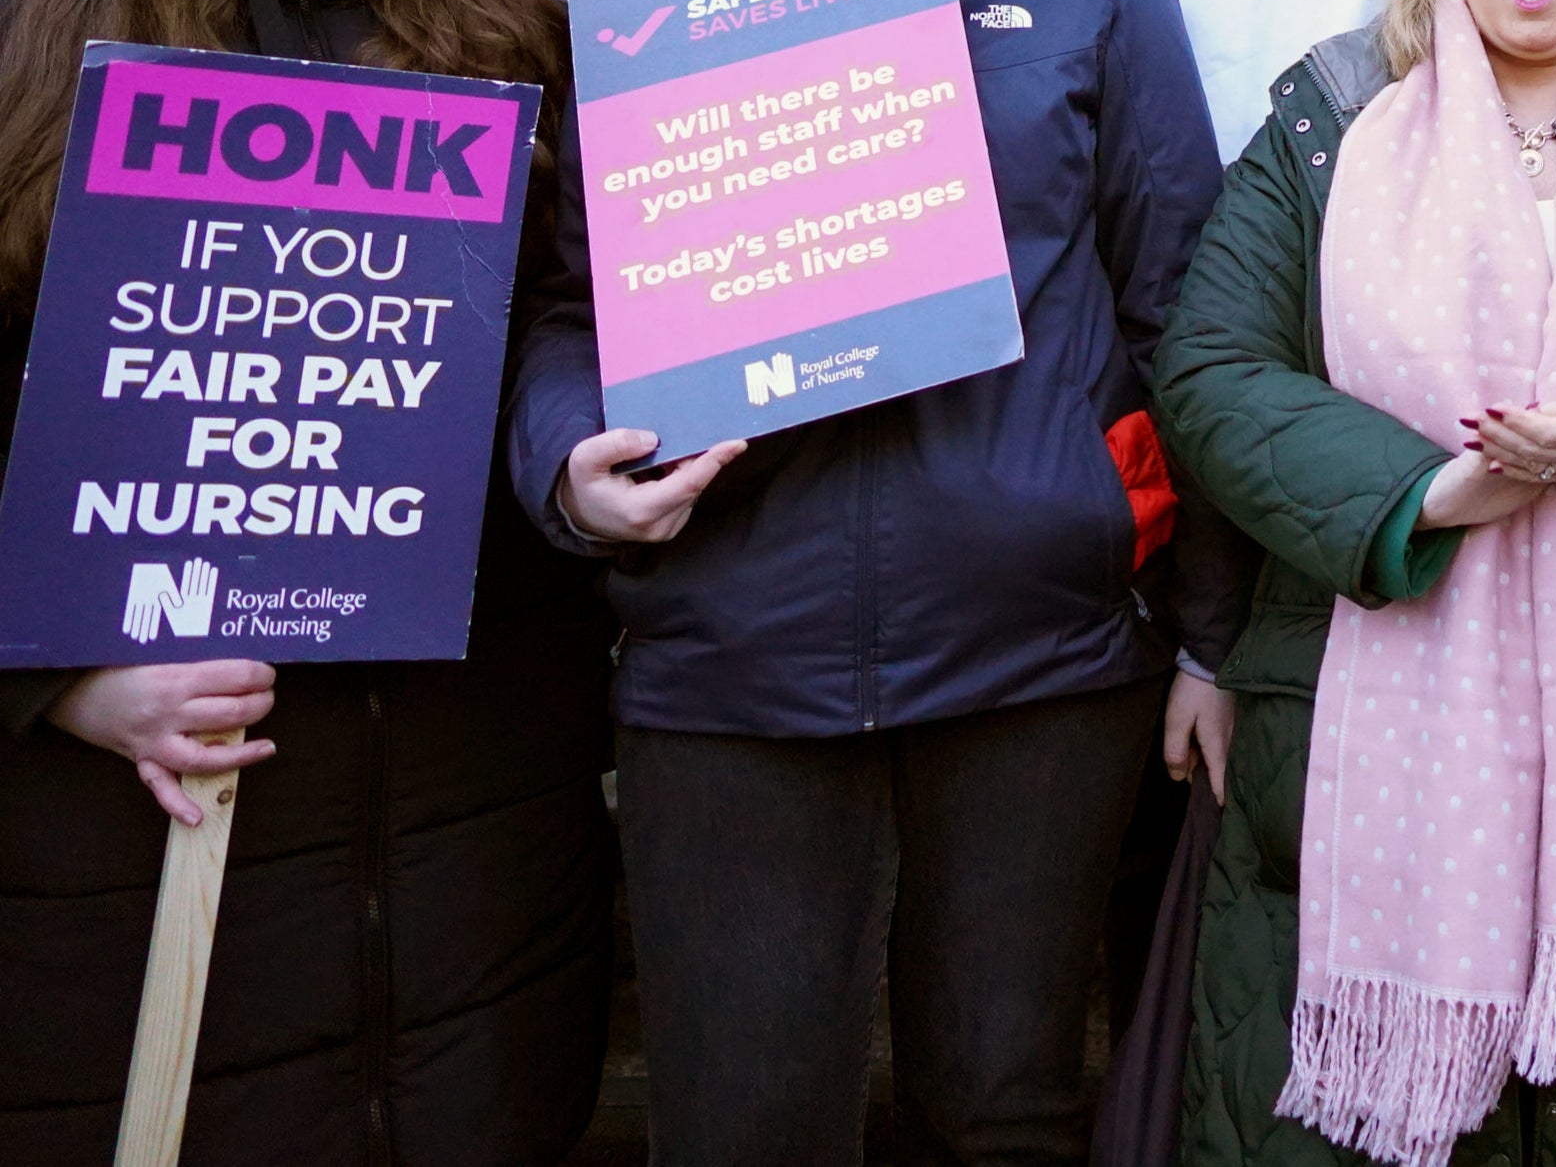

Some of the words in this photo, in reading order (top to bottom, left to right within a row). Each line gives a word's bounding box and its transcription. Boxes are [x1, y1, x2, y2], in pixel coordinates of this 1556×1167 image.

[970, 12, 1010, 21] NORTH
[981, 20, 1011, 28] FACE
[988, 4, 1011, 13] THE
[656, 102, 731, 144] Will
[739, 78, 841, 123] there
[849, 64, 896, 94] be
[122, 91, 493, 199] HONK
[602, 135, 748, 193] enough
[758, 106, 843, 152] staff
[851, 77, 956, 128] when
[642, 180, 712, 223] you
[724, 147, 816, 195] need
[826, 119, 925, 166] care?
[180, 219, 244, 270] IF
[263, 223, 408, 281] YOU
[620, 234, 766, 292] Today's
[775, 177, 966, 247] shortages
[709, 261, 792, 302] cost
[801, 233, 890, 278] lives
[110, 282, 453, 346] SUPPORT
[101, 347, 282, 404] FAIR
[298, 355, 442, 409] PAY
[800, 355, 835, 378] Royal
[834, 344, 879, 368] College
[801, 376, 816, 391] of
[817, 362, 865, 387] Nursing
[185, 416, 342, 471] FOR
[72, 481, 426, 538] NURSING
[221, 614, 247, 636] of
[250, 615, 331, 642] Nursing
[227, 587, 287, 614] Royal
[289, 587, 367, 617] College
